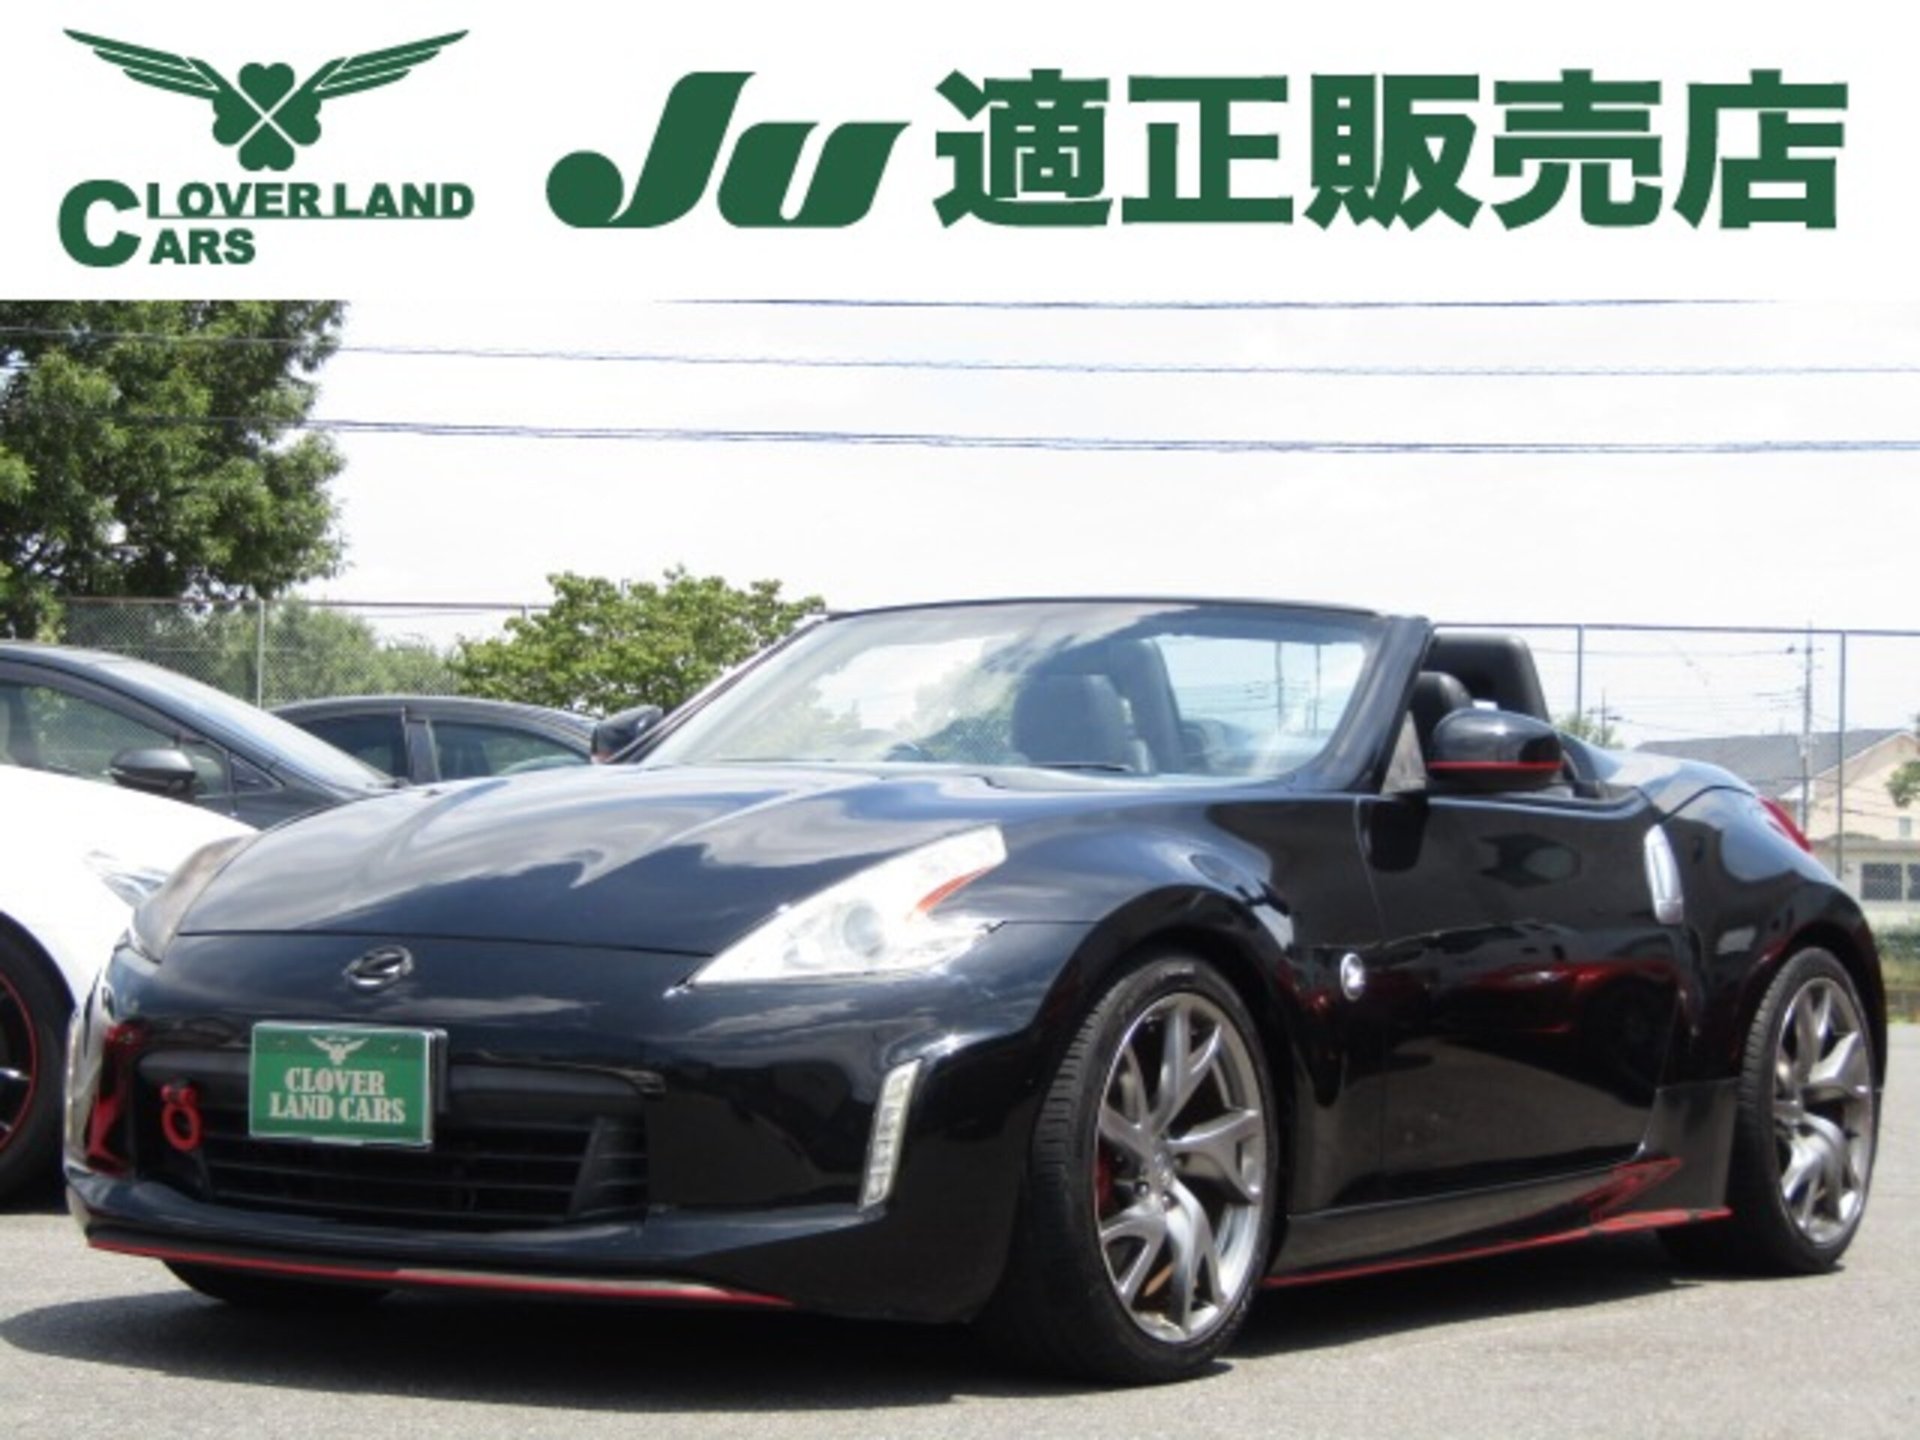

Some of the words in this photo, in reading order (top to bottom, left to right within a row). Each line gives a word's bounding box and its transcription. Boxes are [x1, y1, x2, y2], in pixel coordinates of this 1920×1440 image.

[284, 1066, 386, 1097] CLOVER
[269, 1092, 335, 1121] LAND
[338, 1096, 406, 1125] CARS
